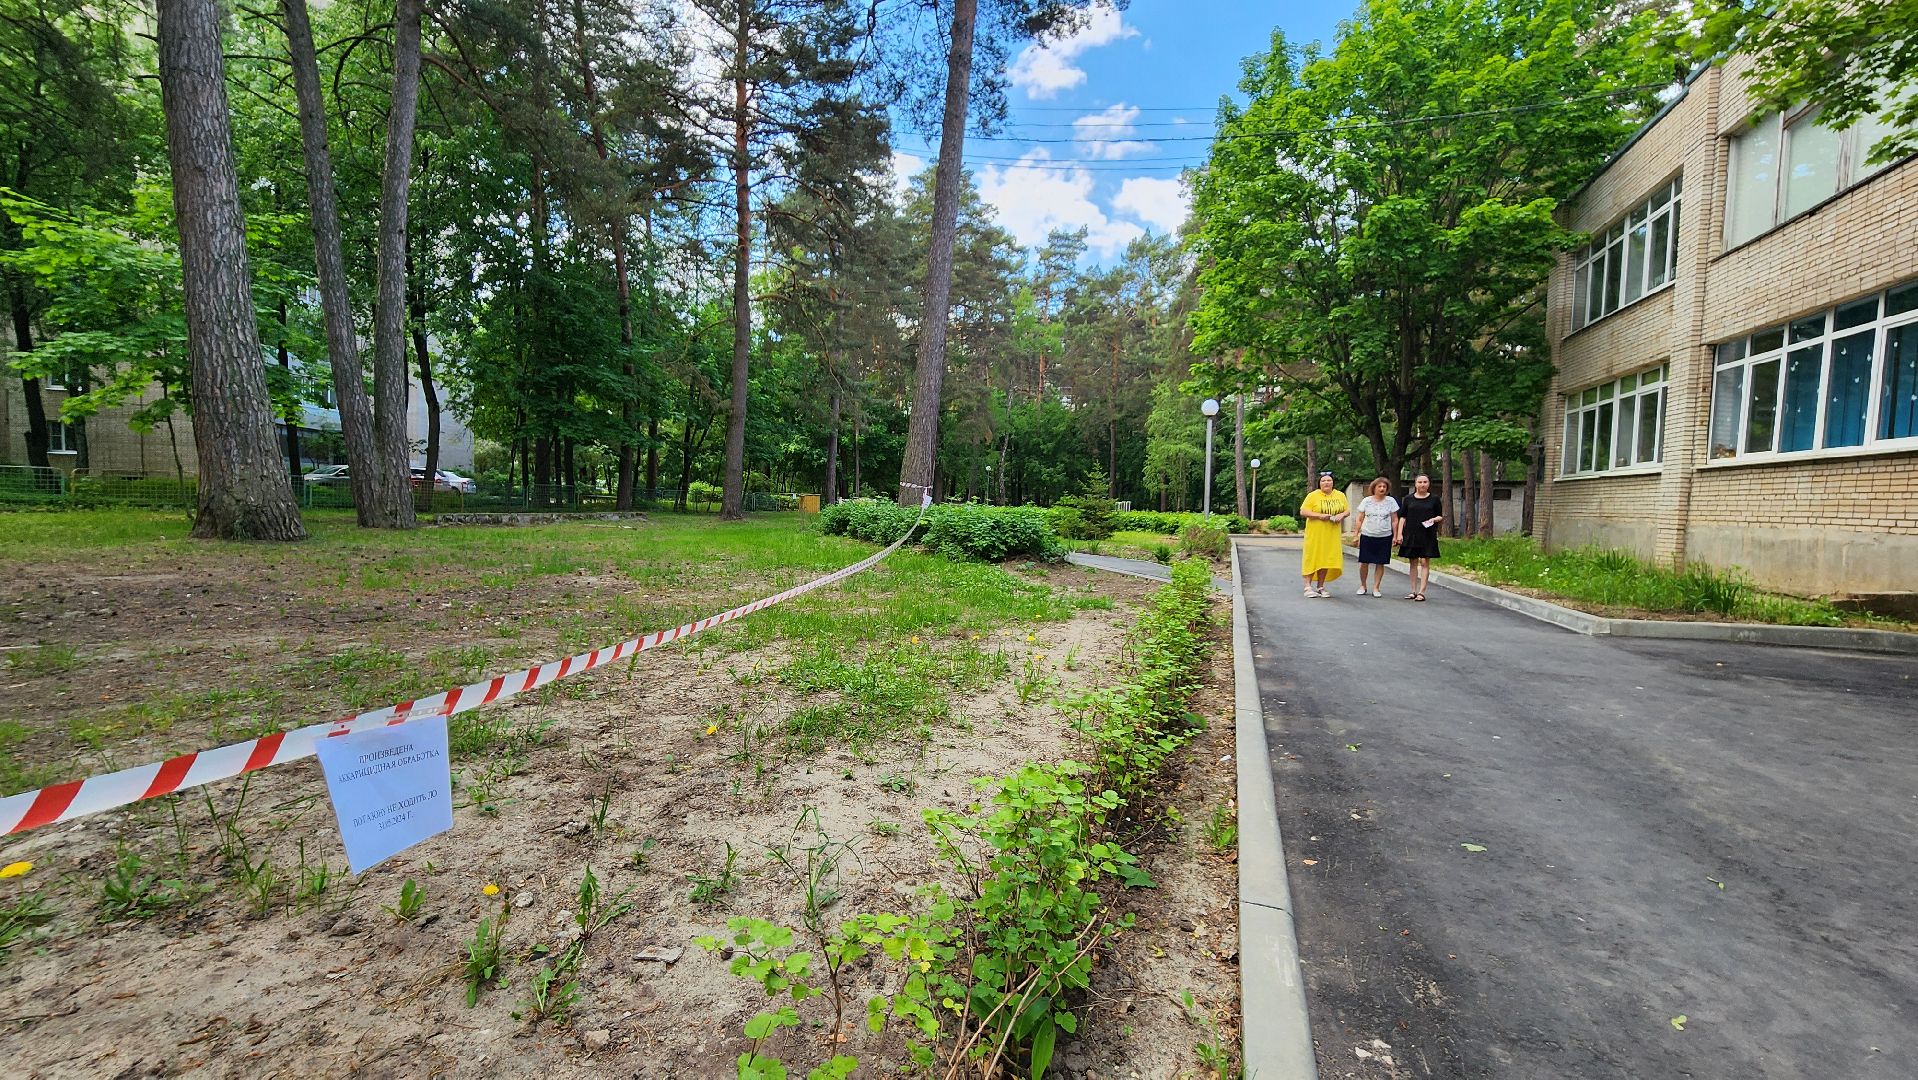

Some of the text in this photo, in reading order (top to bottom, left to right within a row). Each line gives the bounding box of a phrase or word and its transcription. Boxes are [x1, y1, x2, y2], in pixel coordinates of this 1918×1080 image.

[359, 743, 414, 764] ПРОИЗВЕДЕНА
[397, 748, 440, 767] ОБРАБОТКА
[398, 793, 427, 810] ХОДИТЬ
[427, 789, 438, 801] ДО
